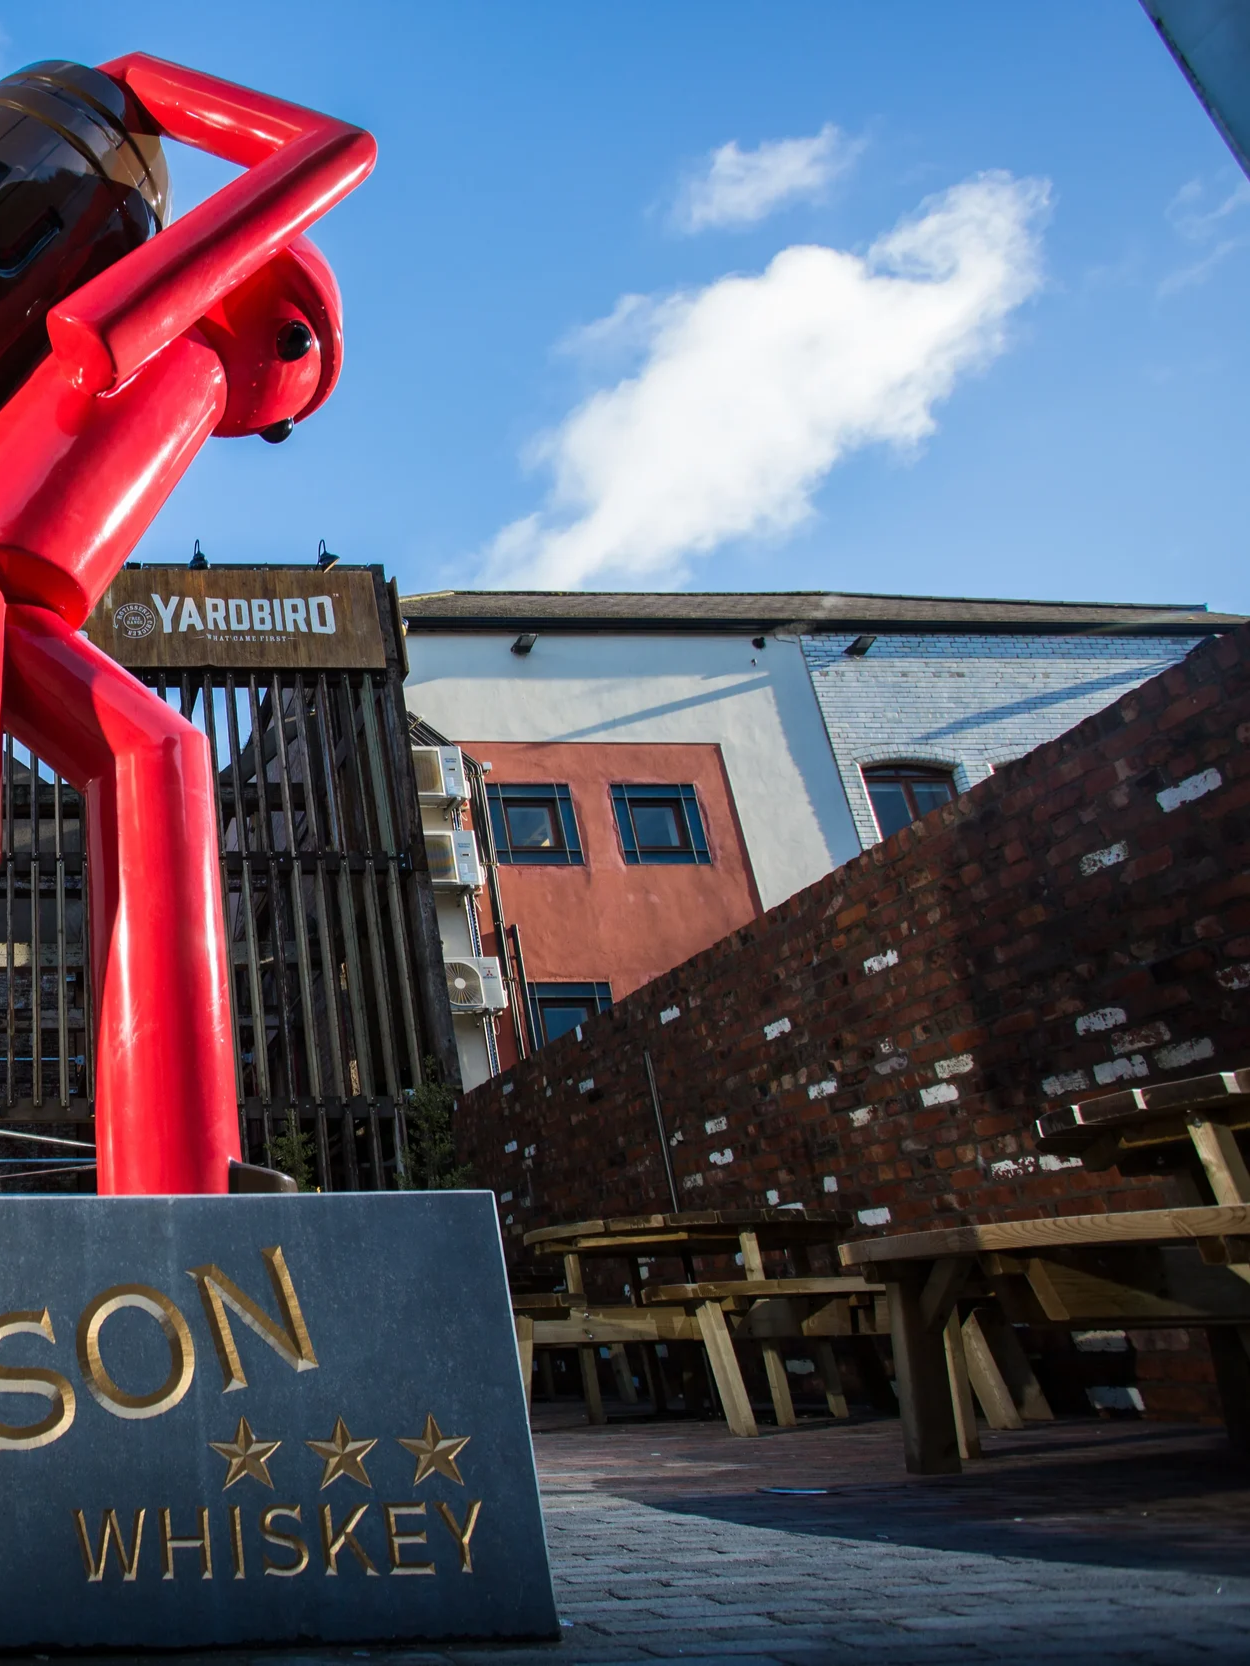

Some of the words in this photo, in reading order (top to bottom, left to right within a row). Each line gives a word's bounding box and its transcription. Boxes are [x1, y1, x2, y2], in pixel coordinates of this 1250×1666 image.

[117, 605, 153, 619] ROTISSERIE
[151, 593, 336, 635] YARDBIRD
[73, 1499, 483, 1583] WHISKEY
